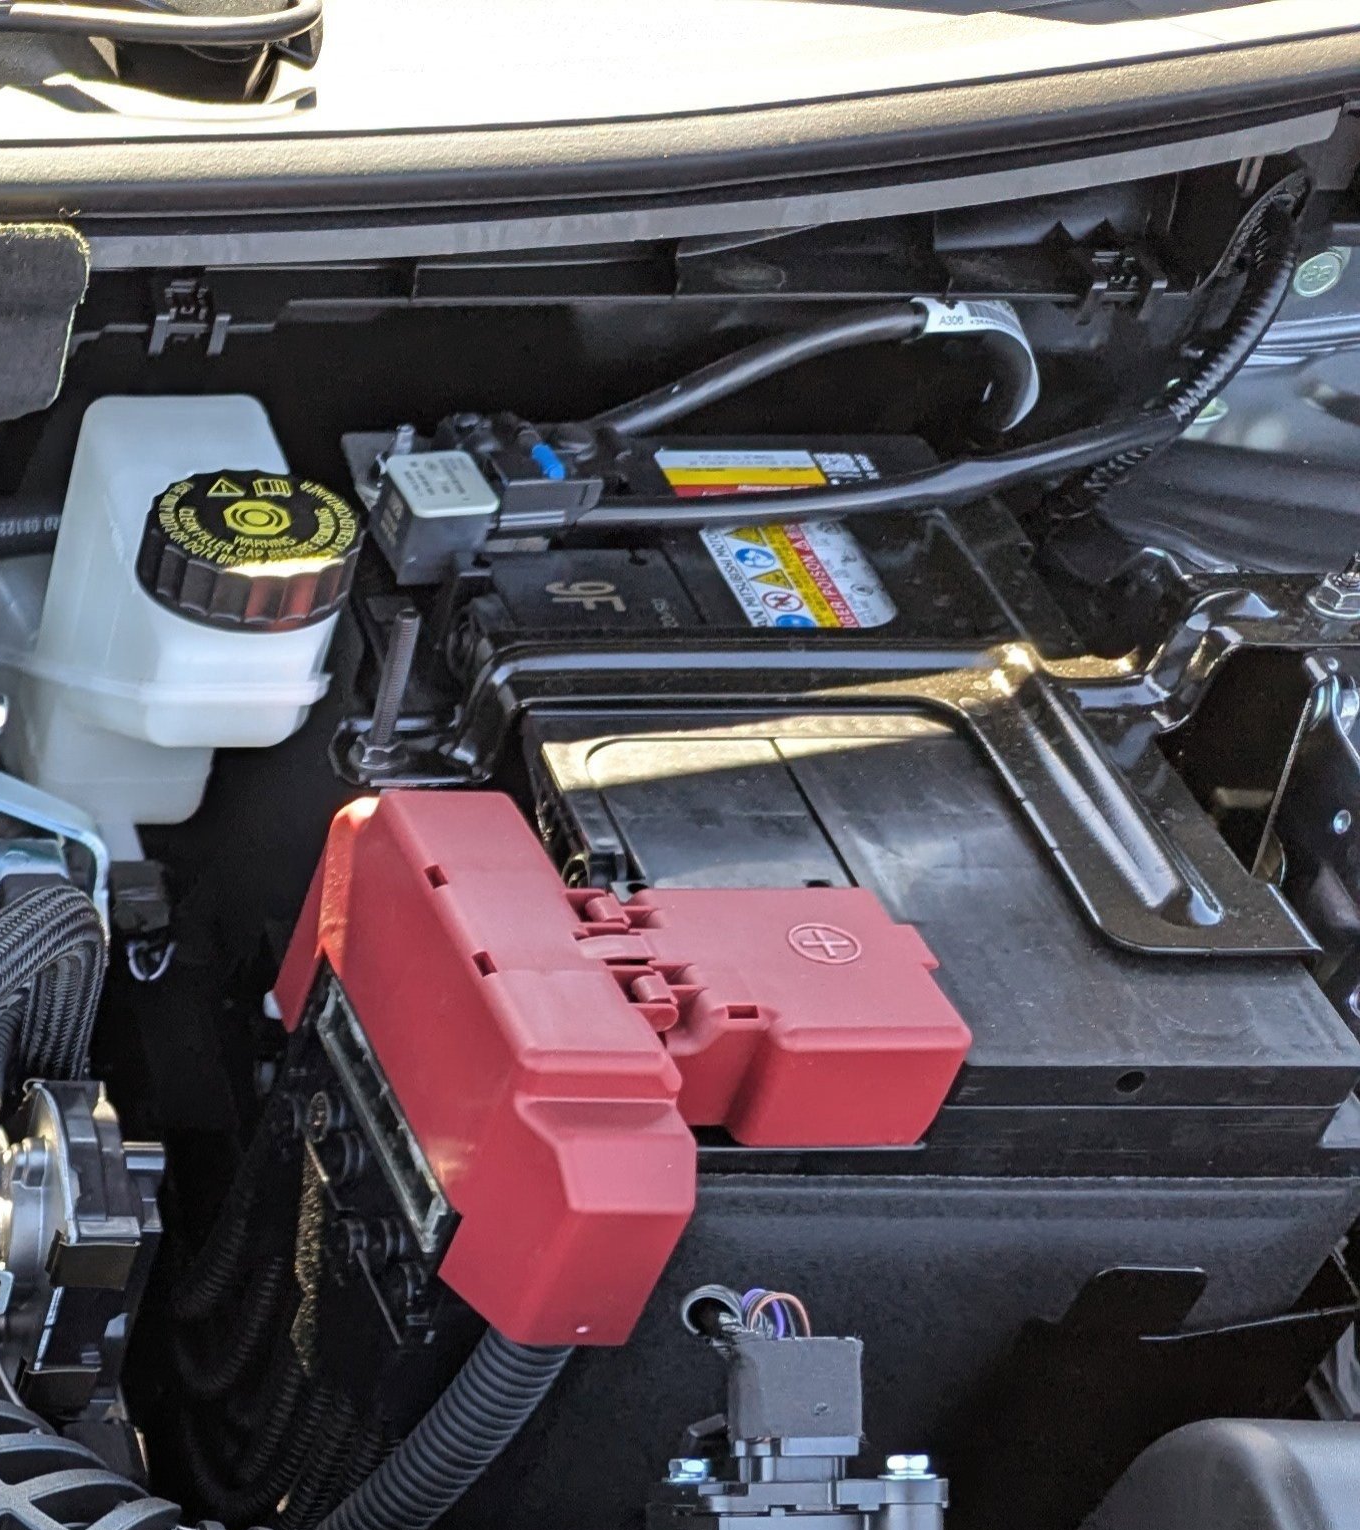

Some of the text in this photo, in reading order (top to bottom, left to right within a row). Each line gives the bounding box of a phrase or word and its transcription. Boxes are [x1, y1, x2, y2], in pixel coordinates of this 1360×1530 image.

[189, 530, 236, 554] FILLER
[233, 547, 265, 557] CAP
[233, 535, 297, 549] WARNING
